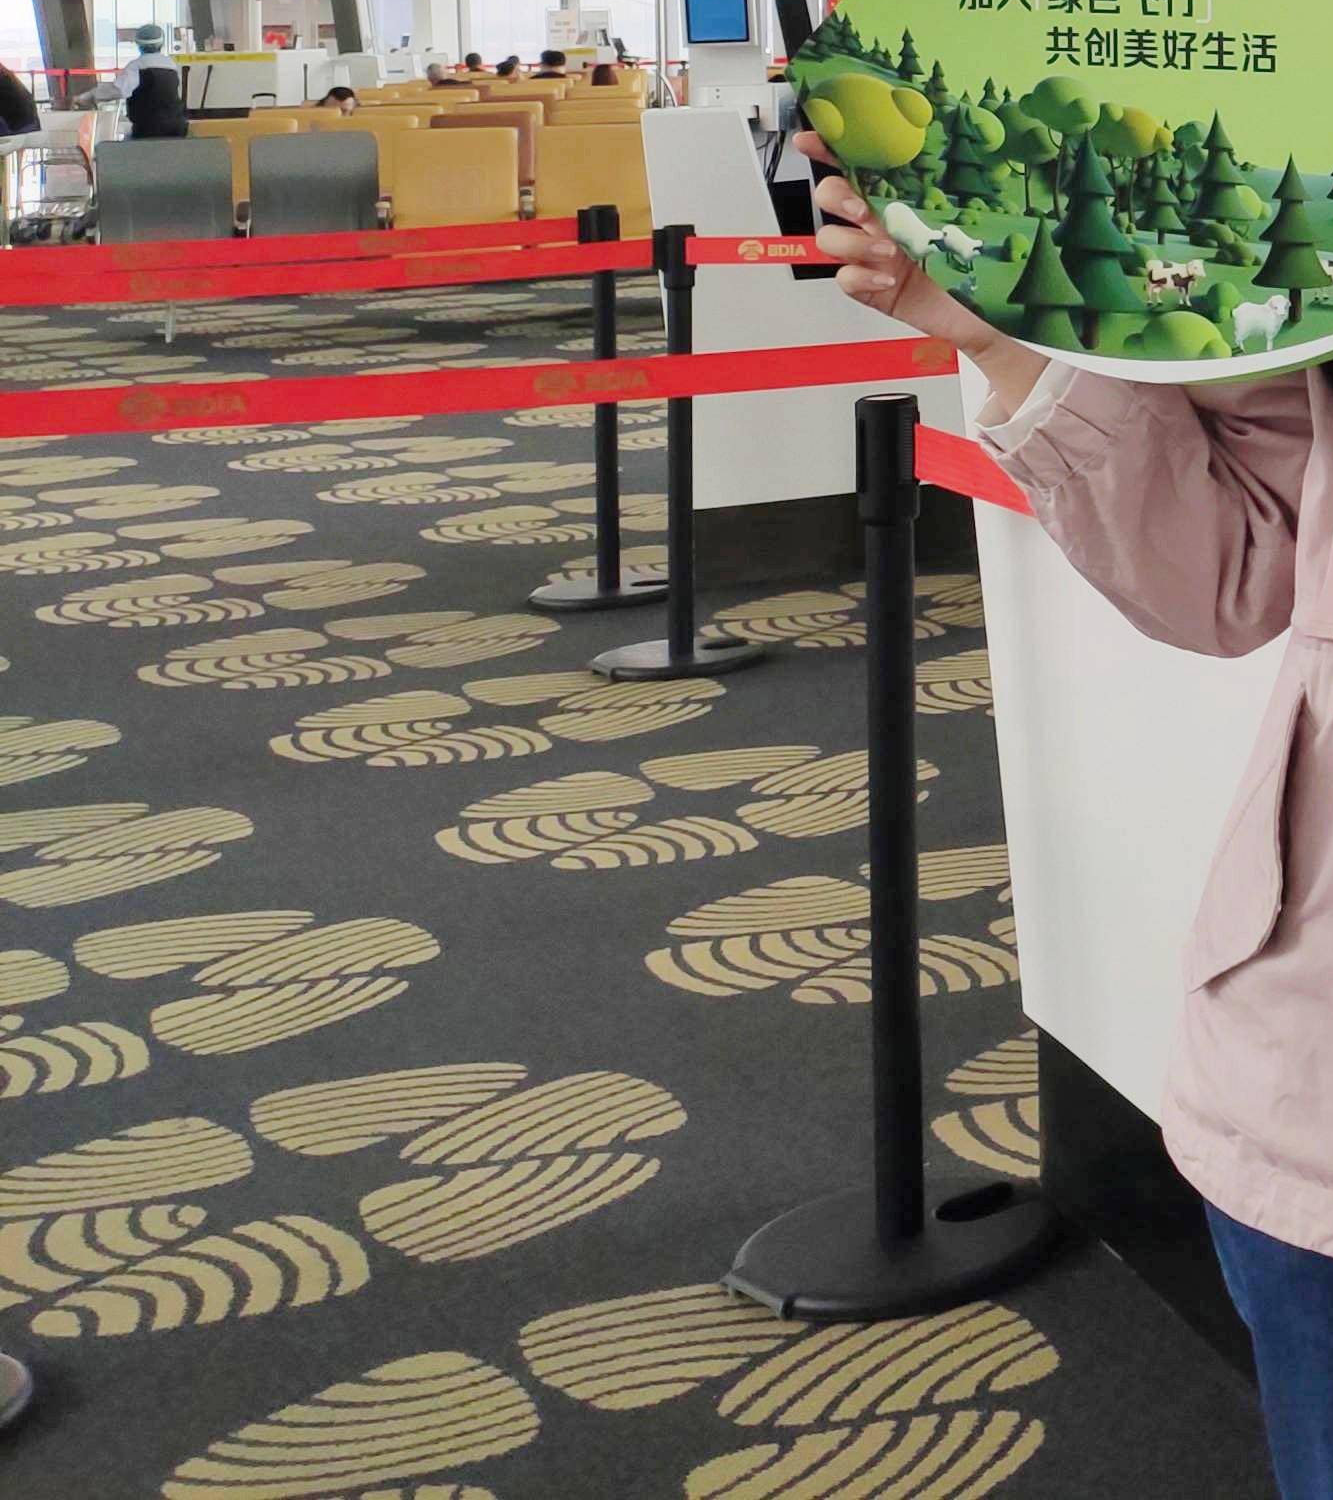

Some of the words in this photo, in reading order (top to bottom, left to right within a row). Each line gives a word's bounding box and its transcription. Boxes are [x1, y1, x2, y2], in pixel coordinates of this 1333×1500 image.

[1046, 26, 1277, 73] 共创美好生活
